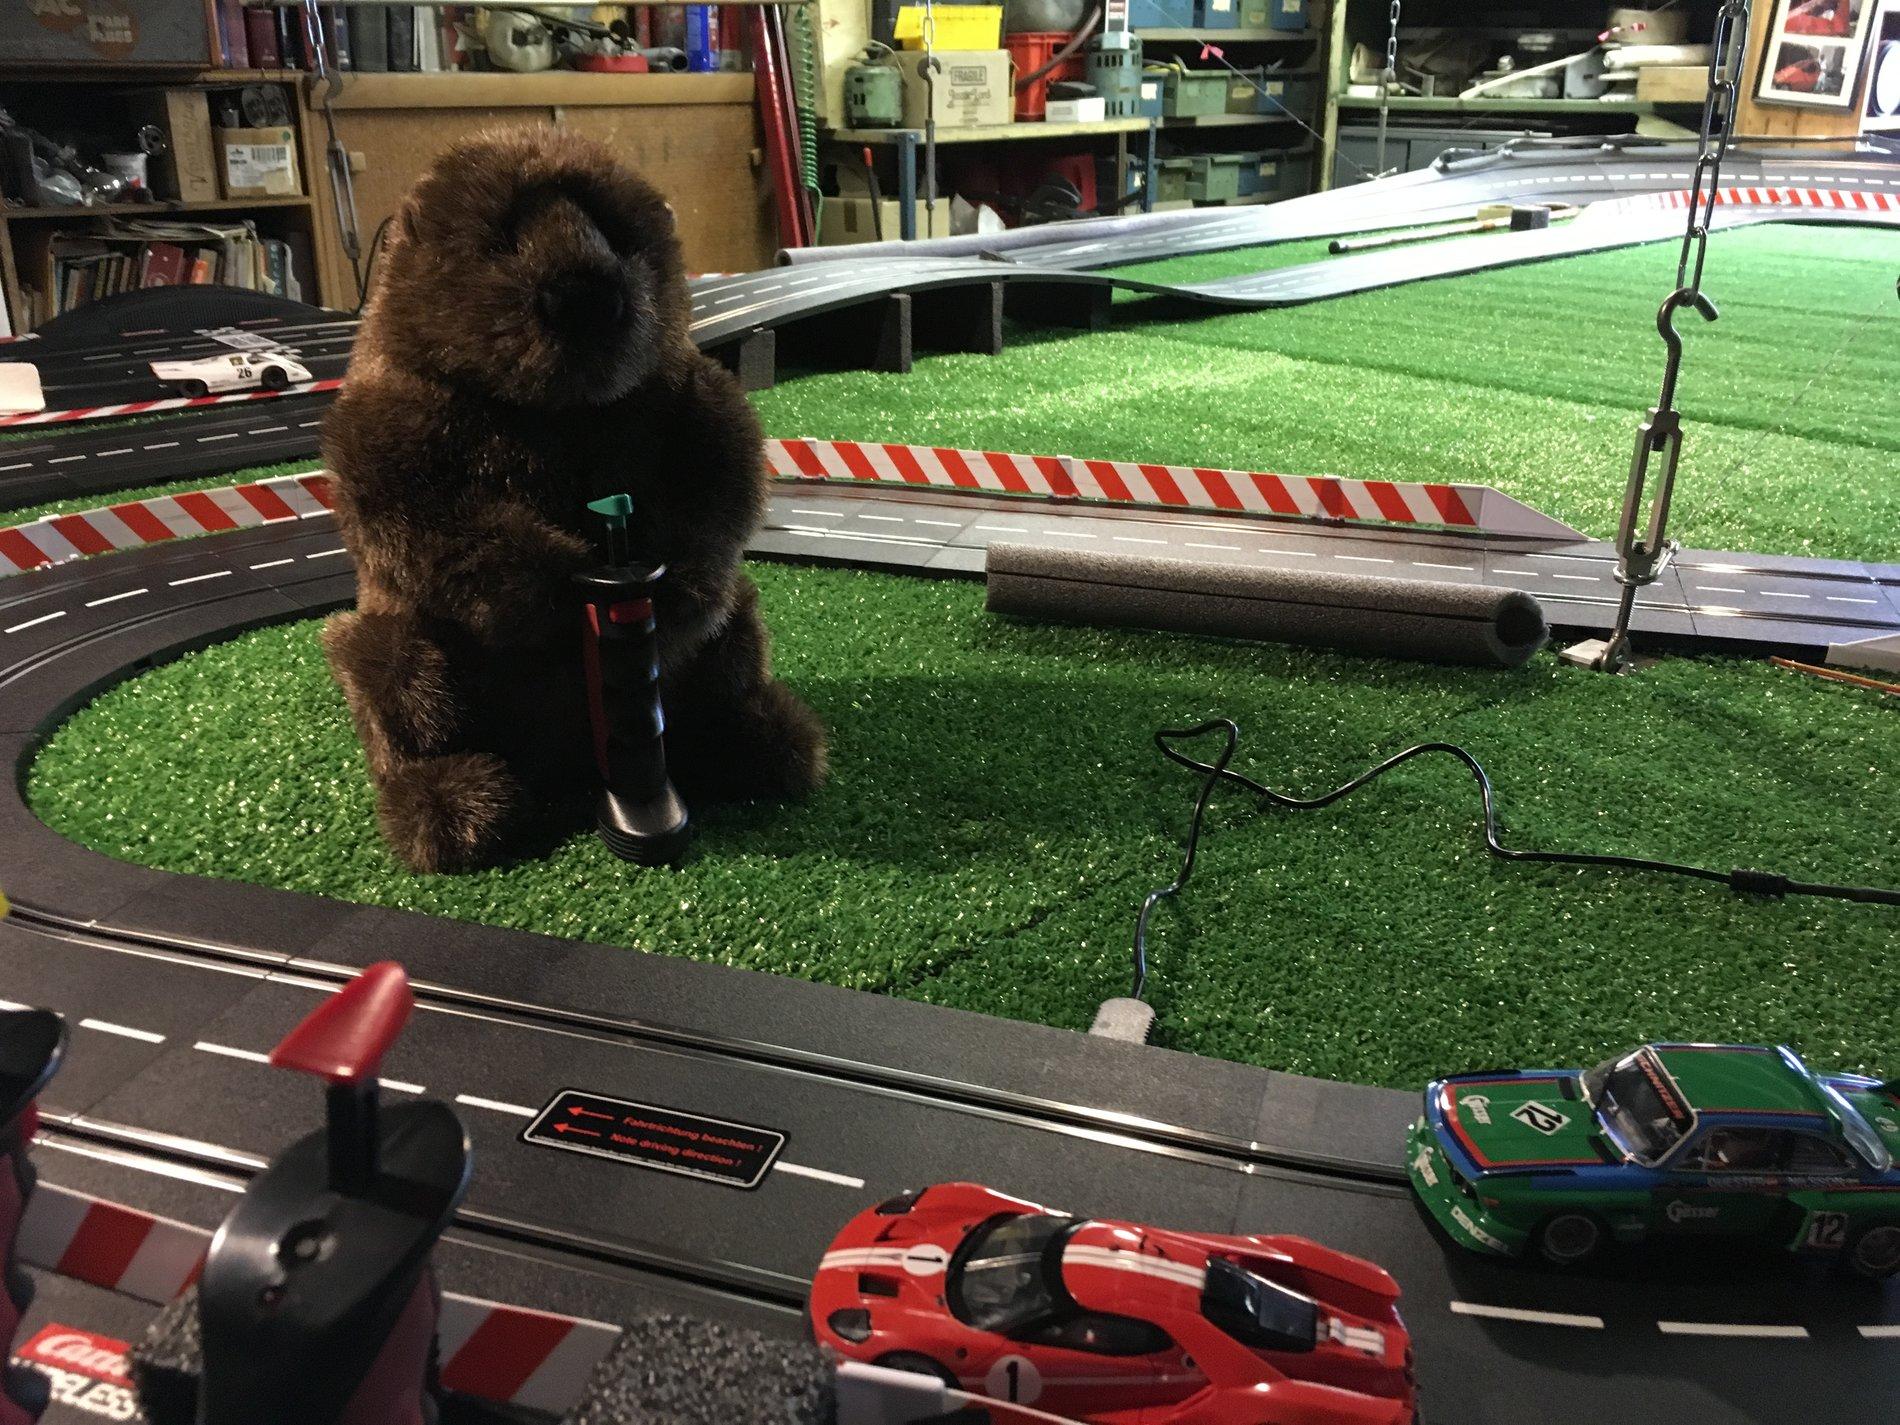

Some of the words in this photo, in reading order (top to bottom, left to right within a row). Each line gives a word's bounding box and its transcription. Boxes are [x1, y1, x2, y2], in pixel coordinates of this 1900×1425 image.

[953, 69, 984, 82] FRAGILE
[236, 366, 253, 379] 26
[1515, 1104, 1564, 1132] 12
[622, 1116, 700, 1141] Fahrtrichtung
[701, 1132, 757, 1152] beachten
[610, 1133, 637, 1146] Note
[639, 1139, 680, 1157] driving
[681, 1146, 734, 1166] direction
[1814, 1213, 1843, 1242] 12
[1006, 1360, 1019, 1402] 1
